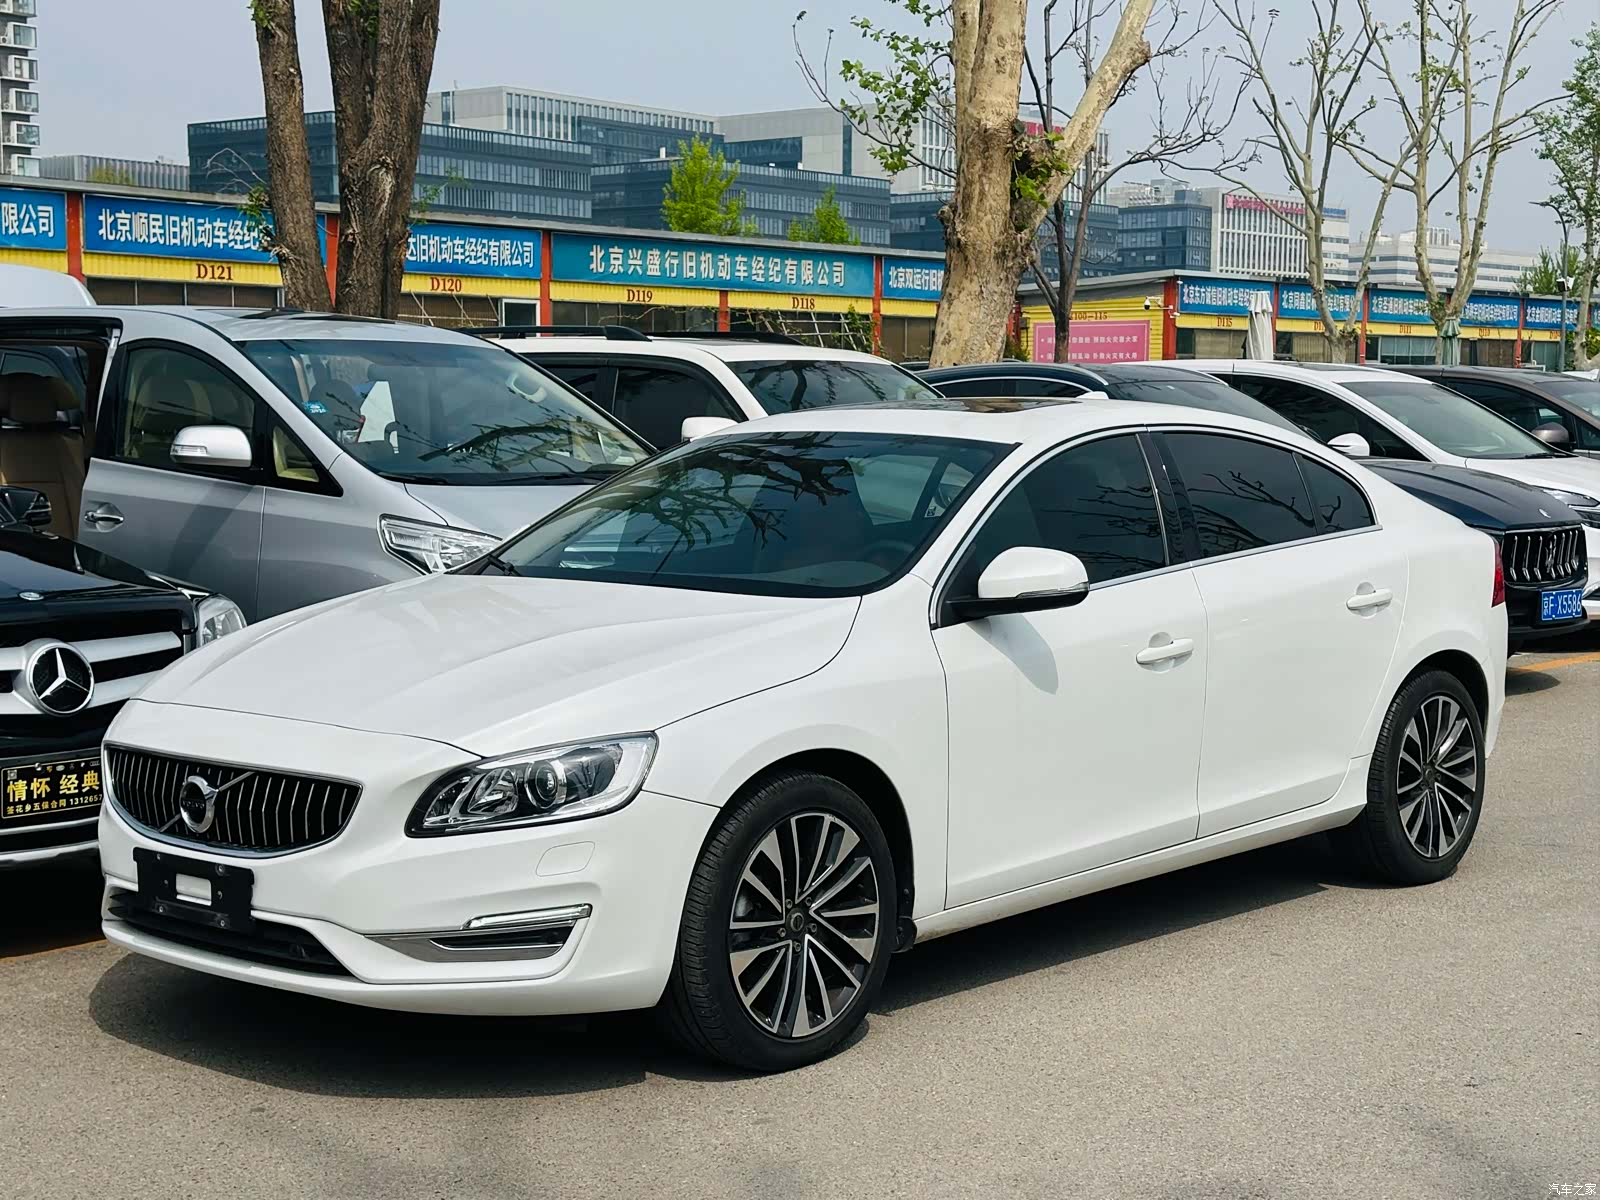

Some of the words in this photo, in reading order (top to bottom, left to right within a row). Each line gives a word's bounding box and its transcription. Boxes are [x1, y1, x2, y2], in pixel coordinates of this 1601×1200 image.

[1, 202, 55, 238] 限公司
[196, 263, 234, 281] D121
[589, 244, 845, 288] 北京兴盛行旧机动车经纪有限公司
[430, 276, 462, 293] D120
[626, 288, 653, 303] D119
[791, 296, 816, 310] D118
[7, 777, 51, 803] 情怀
[59, 769, 100, 795] 经典
